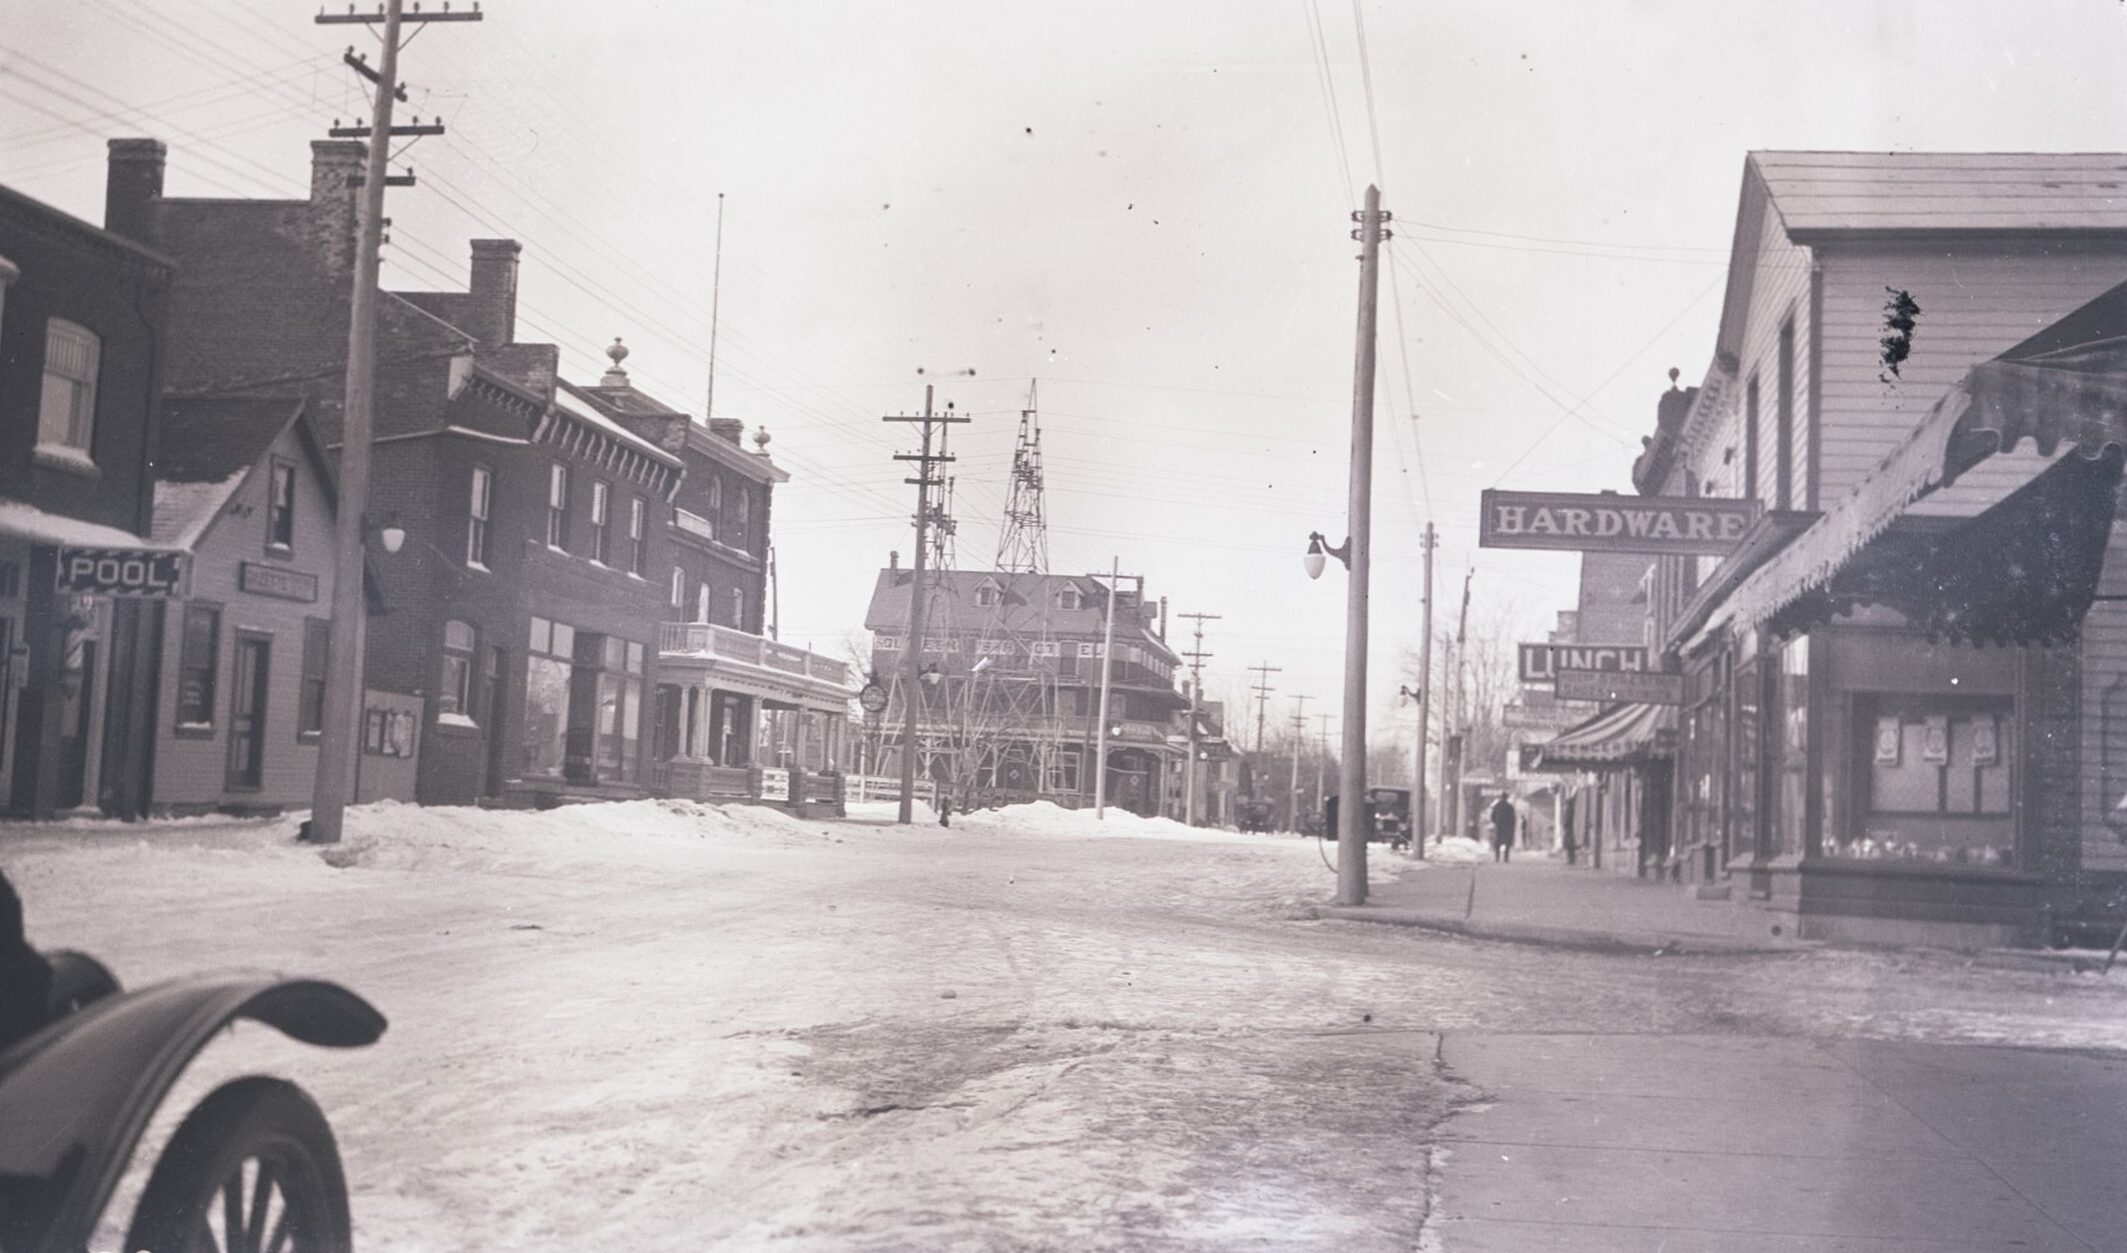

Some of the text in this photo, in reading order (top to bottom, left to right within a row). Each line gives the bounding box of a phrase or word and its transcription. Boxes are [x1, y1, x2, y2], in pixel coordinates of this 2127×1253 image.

[1496, 505, 1746, 541] HARDWARE
[69, 557, 169, 588] POOL
[1524, 648, 1642, 679] LUNCH
